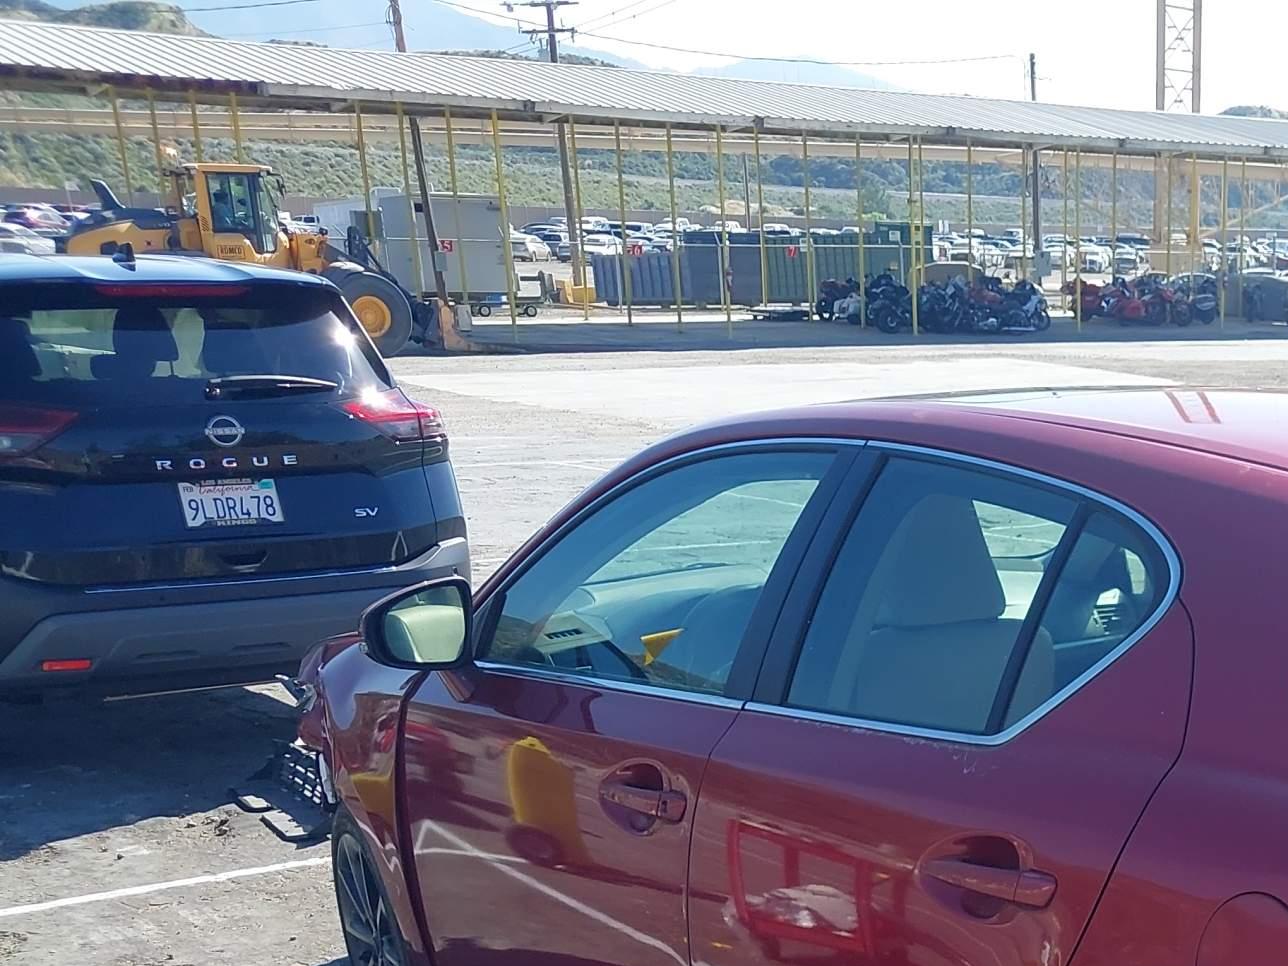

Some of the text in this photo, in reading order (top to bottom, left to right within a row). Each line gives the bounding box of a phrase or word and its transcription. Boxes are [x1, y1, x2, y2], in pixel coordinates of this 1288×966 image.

[205, 427, 245, 435] NISSAN
[155, 454, 298, 471] ROGUE
[188, 495, 277, 521] 9LDR478
[354, 507, 379, 517] SV
